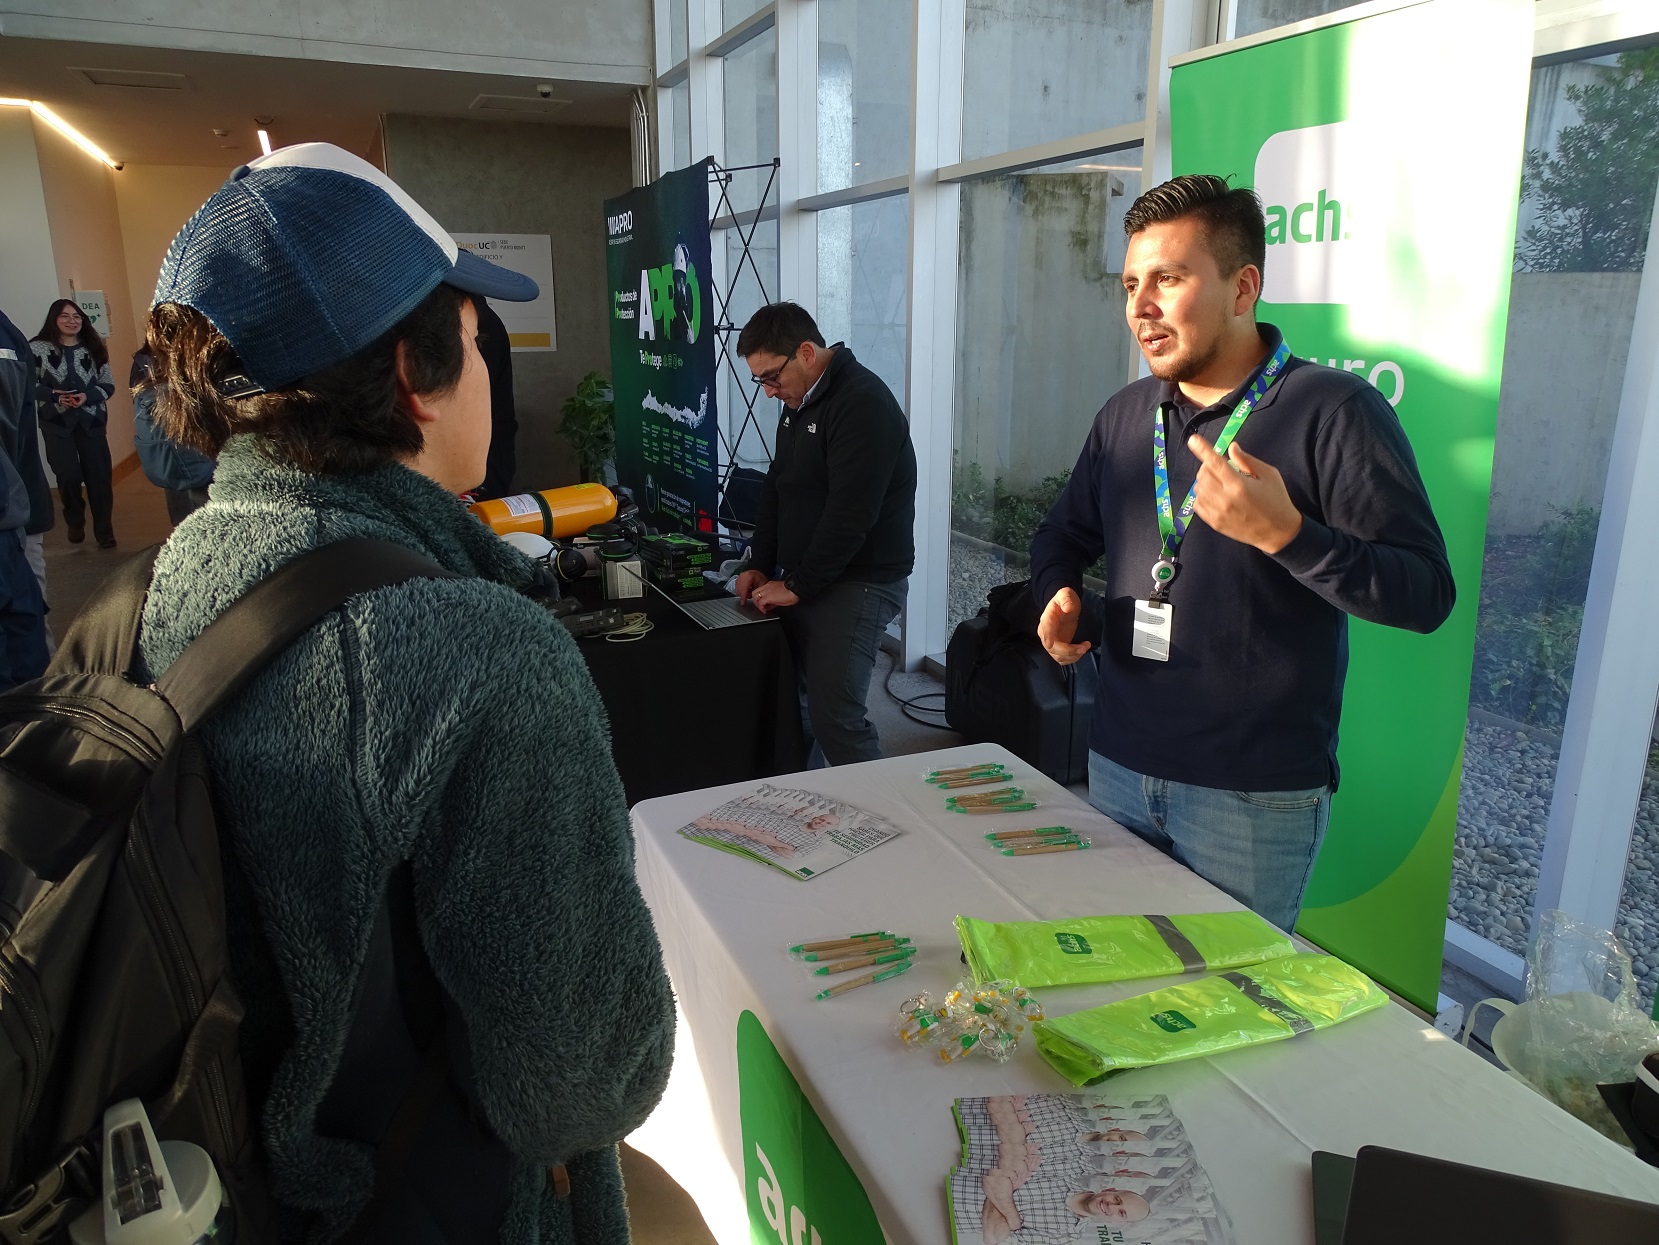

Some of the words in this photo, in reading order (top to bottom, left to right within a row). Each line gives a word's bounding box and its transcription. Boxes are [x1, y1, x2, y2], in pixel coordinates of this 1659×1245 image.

[1266, 189, 1353, 245] ach
[479, 242, 490, 250] UC
[82, 302, 100, 310] DEA
[1266, 359, 1280, 376] achs
[1236, 399, 1252, 418] achs
[1157, 452, 1165, 470] achs
[1161, 499, 1170, 518] achs
[1182, 496, 1196, 515] achs
[1096, 1224, 1112, 1245] TRA
[1111, 1231, 1124, 1243] TU
